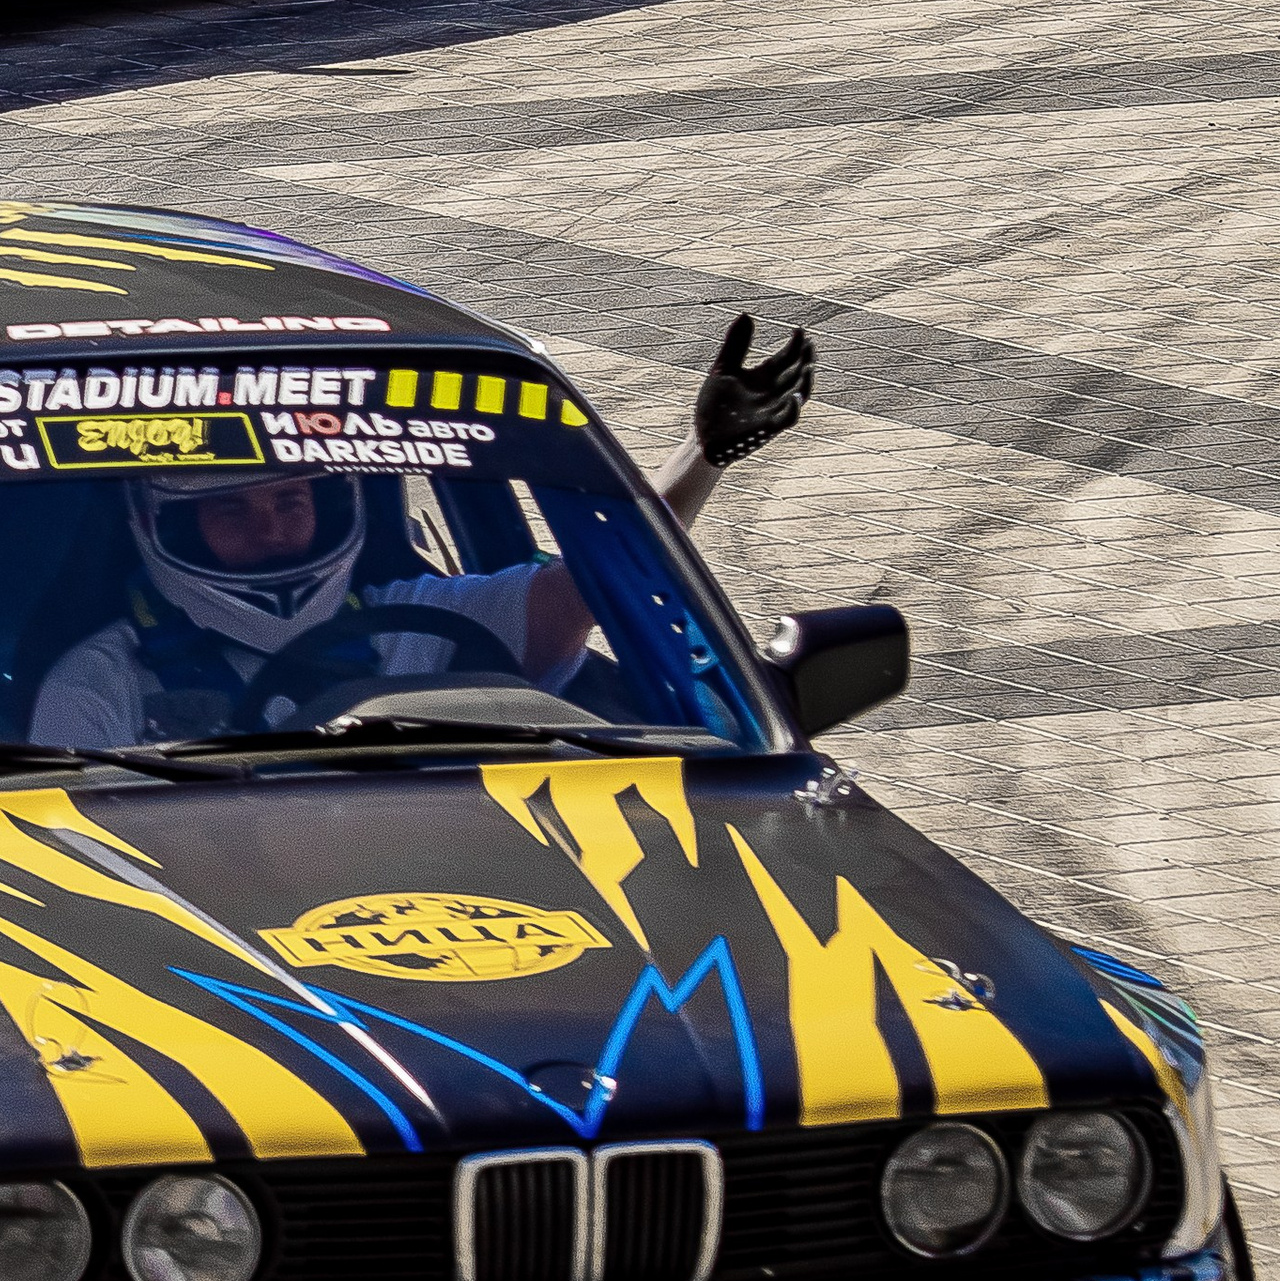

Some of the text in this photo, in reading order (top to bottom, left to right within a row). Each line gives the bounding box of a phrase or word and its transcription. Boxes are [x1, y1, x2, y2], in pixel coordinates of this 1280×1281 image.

[6, 316, 392, 341] DETAILING
[407, 419, 496, 442] авто
[269, 438, 472, 467] DARKSIDE
